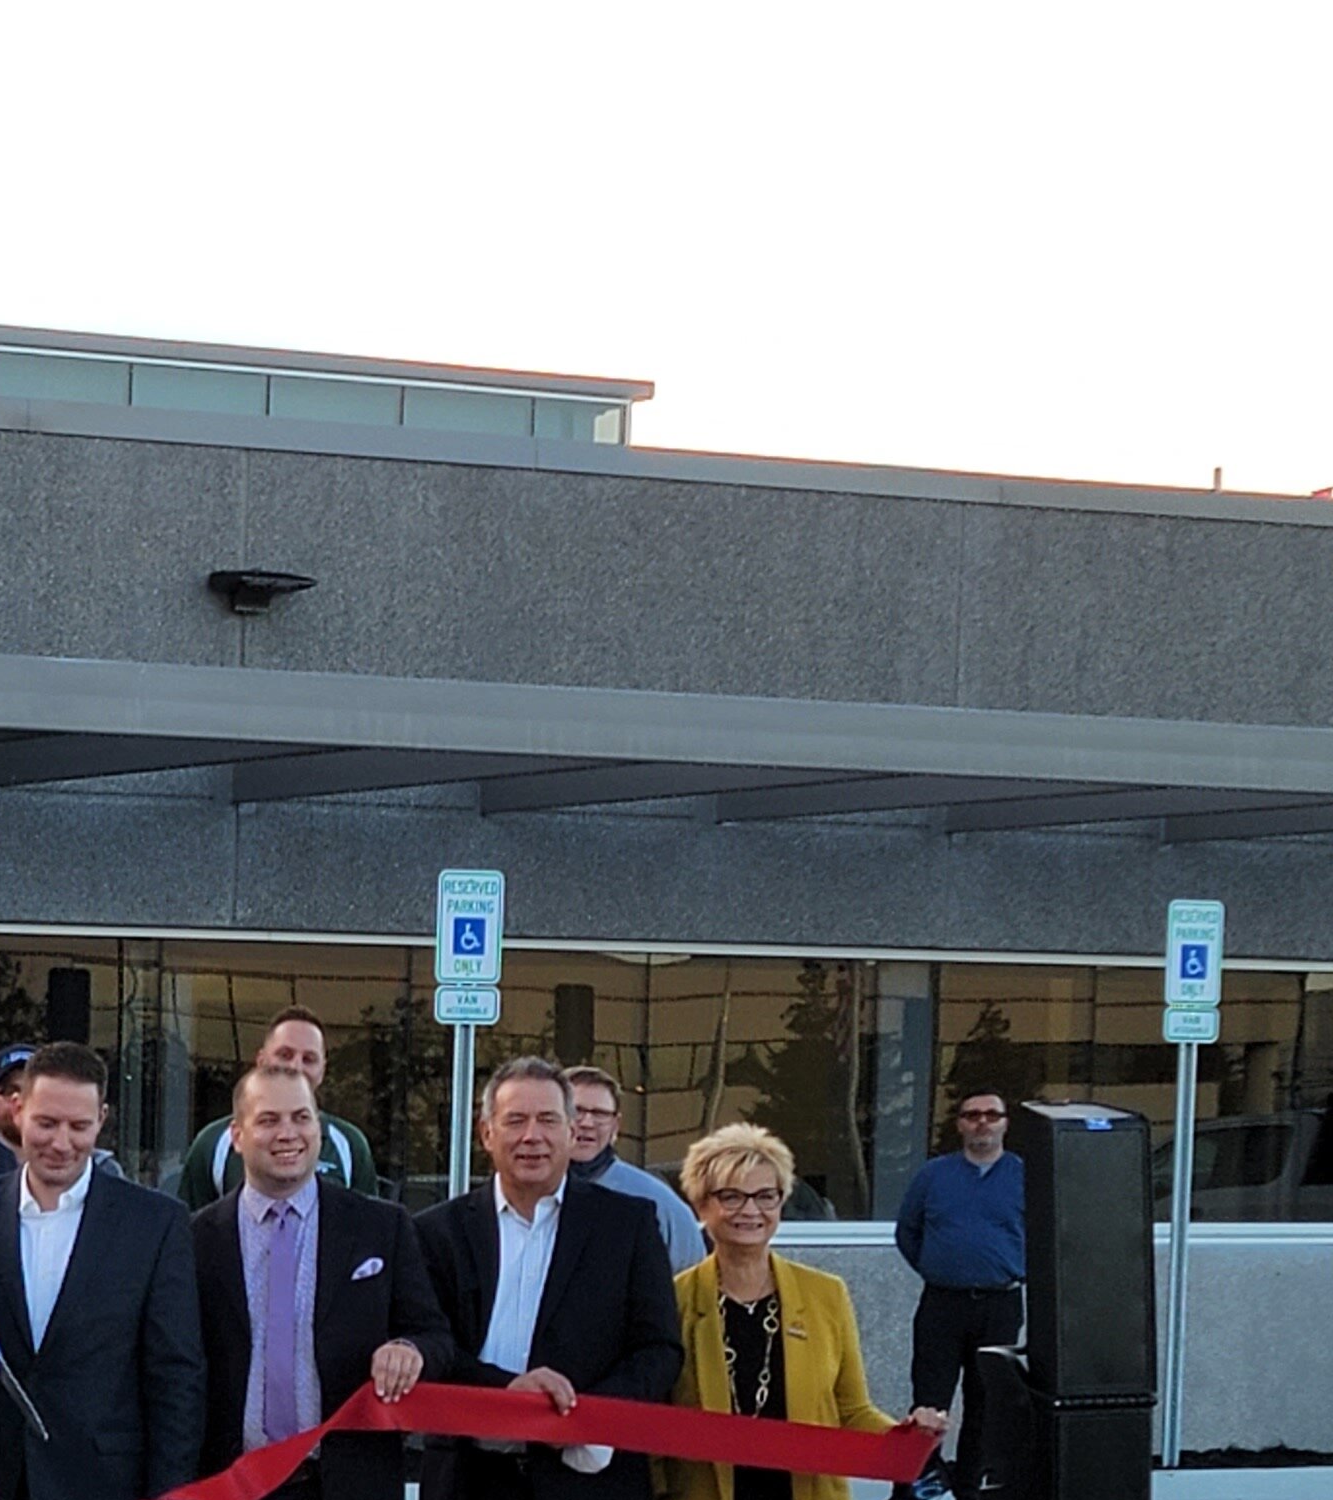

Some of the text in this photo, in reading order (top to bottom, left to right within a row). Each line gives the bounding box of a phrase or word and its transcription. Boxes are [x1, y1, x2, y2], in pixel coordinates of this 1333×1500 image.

[444, 880, 498, 895] RESERVED
[446, 899, 495, 914] PARKING
[454, 959, 482, 974] ONLY
[455, 994, 479, 1005] VAN
